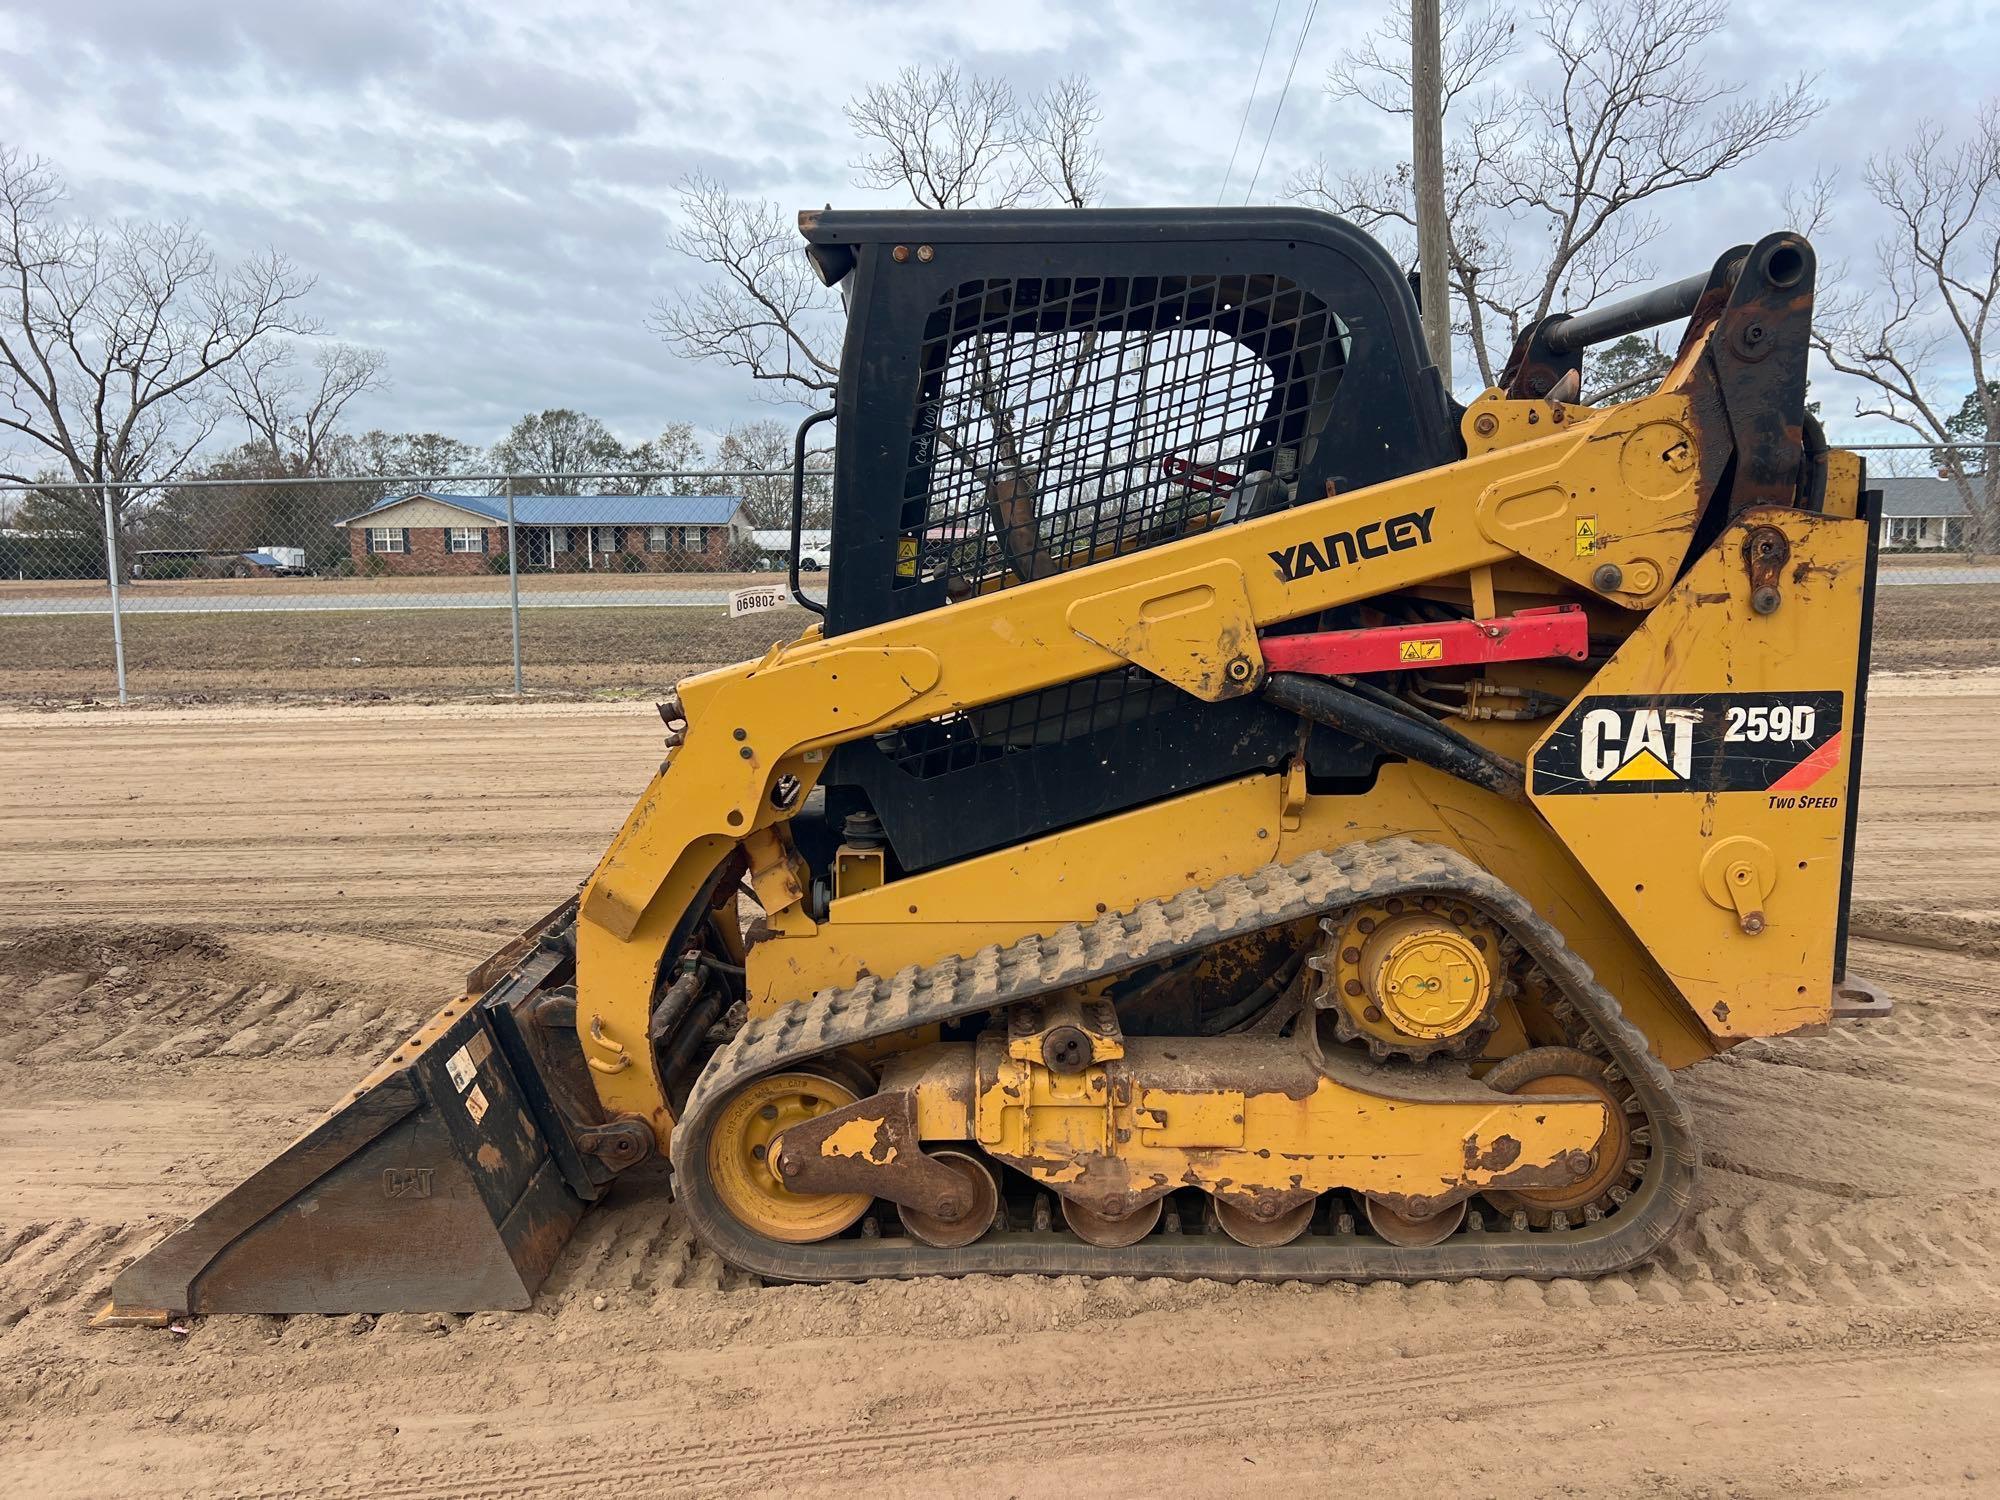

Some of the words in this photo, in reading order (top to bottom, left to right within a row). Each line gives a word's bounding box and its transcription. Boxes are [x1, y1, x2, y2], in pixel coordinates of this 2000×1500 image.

[1267, 506, 1436, 583] YANCEY
[736, 595, 775, 611] 208690
[1723, 705, 1816, 742] 259D
[1580, 707, 1704, 782] CAT
[383, 1168, 434, 1198] CAT
